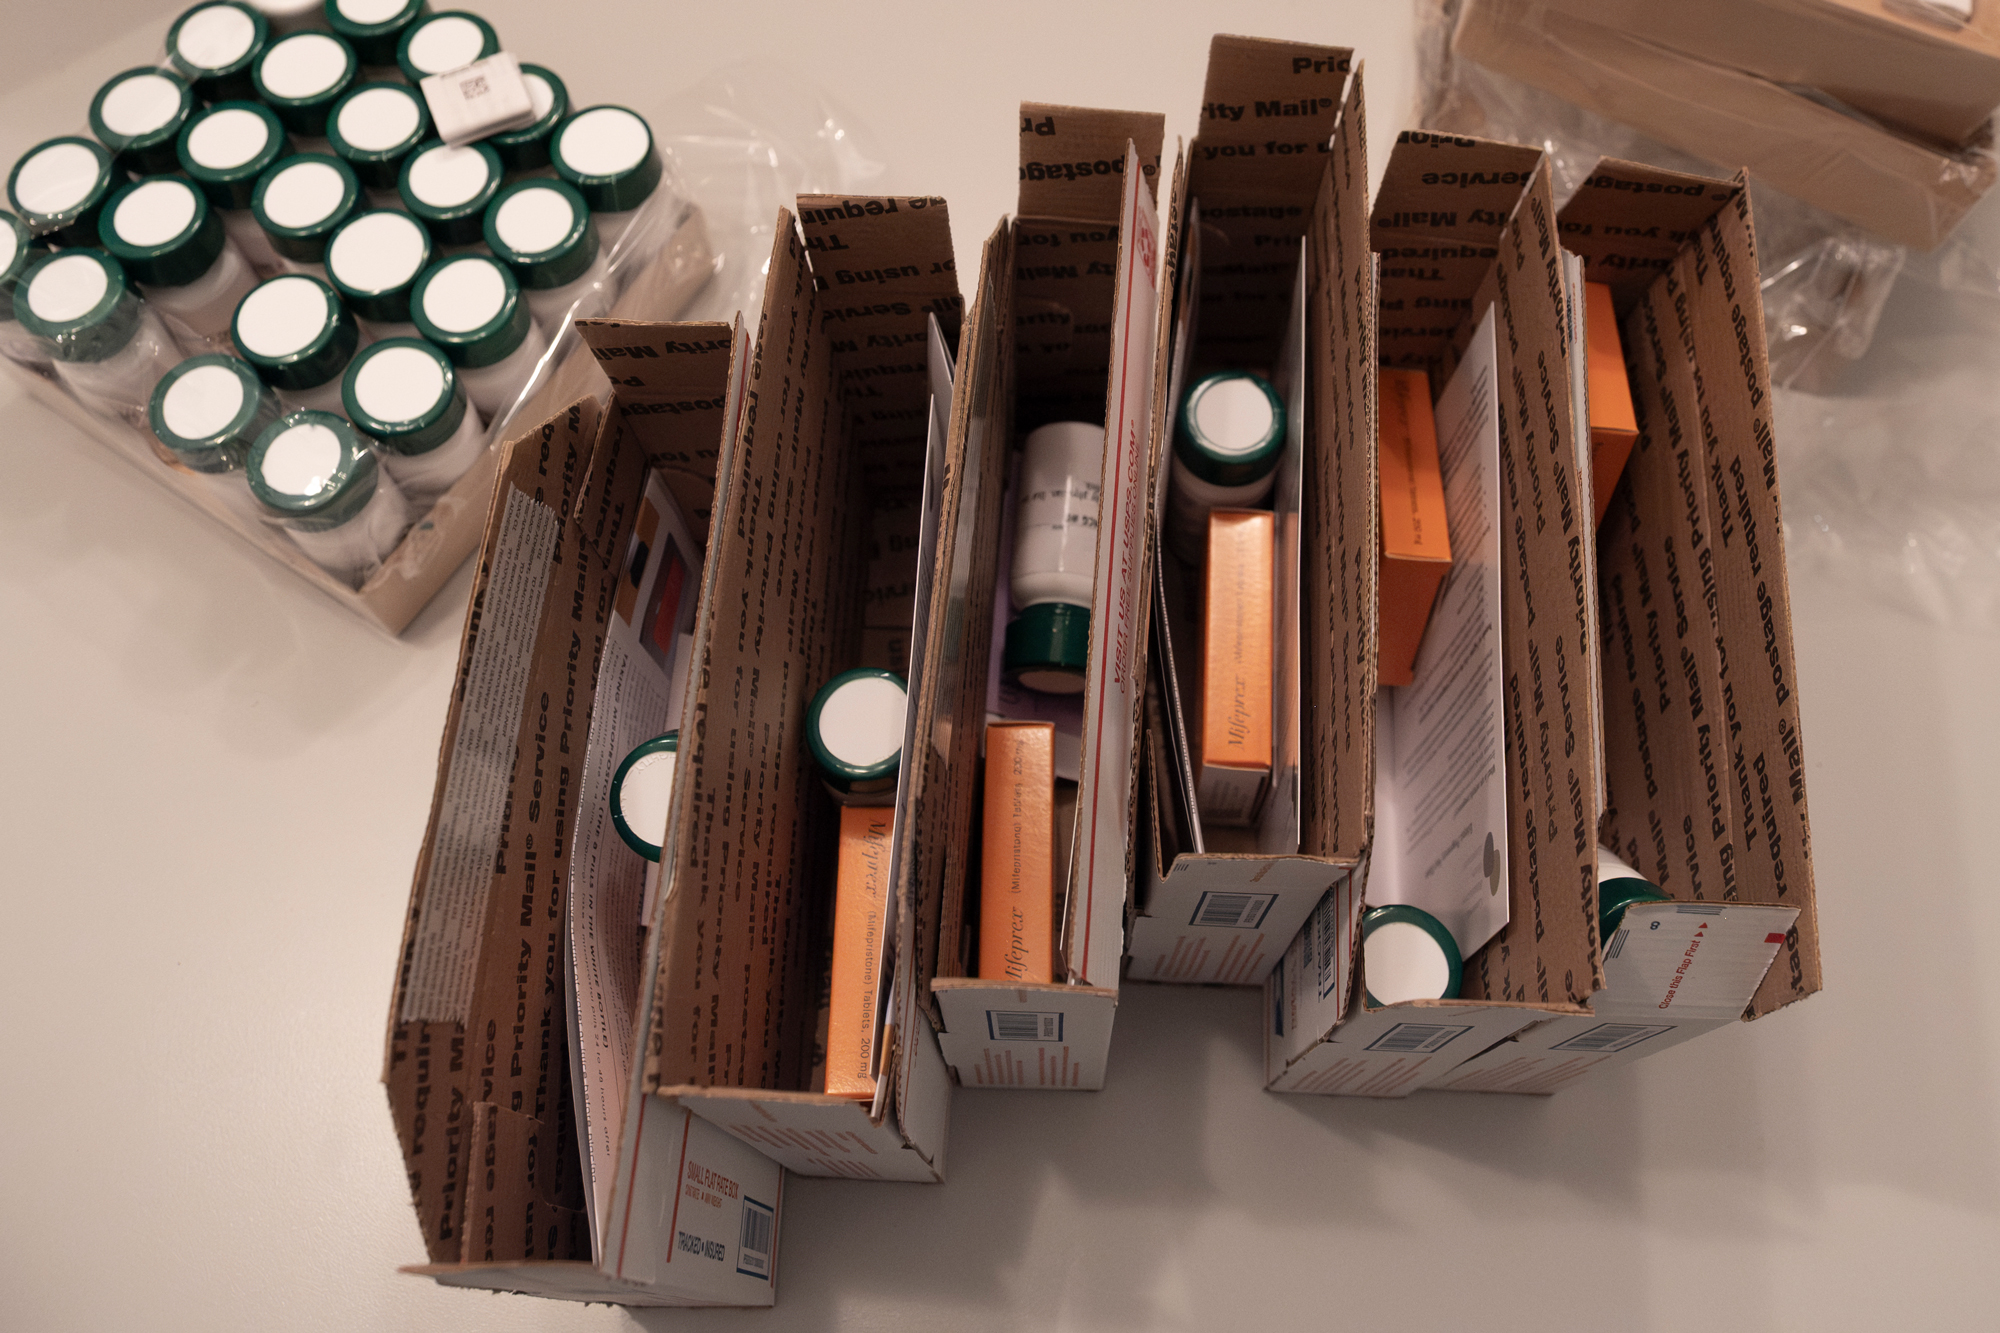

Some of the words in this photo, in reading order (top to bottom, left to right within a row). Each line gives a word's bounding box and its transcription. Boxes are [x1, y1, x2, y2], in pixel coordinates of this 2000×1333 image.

[1254, 98, 1332, 118] Mail®
[1204, 143, 1256, 160] you
[1264, 141, 1308, 155] for
[1604, 226, 1660, 239] you
[834, 264, 920, 286] using
[786, 306, 798, 365] you
[1731, 304, 1762, 410] postage
[780, 375, 790, 423] for
[1535, 351, 1560, 454] Service
[1699, 405, 1719, 456] you
[736, 391, 759, 537] required
[767, 431, 783, 519] using
[1497, 401, 1521, 513] required
[1523, 431, 1548, 535] Priority
[553, 442, 578, 564] Priority
[744, 476, 761, 577] Thank
[794, 446, 810, 559] Priority
[1553, 461, 1573, 535] Mail®
[1676, 448, 1702, 550] Priority
[1707, 456, 1736, 548] Thank
[1730, 454, 1762, 578] required
[492, 548, 504, 585] REMOVE
[776, 477, 794, 593] Service
[1120, 551, 1128, 583] AT
[486, 586, 496, 613] LINER
[506, 562, 518, 599] REMOVE
[518, 576, 530, 613] REMOVE
[524, 588, 534, 622] EXPOSE
[530, 575, 537, 587] TO
[754, 531, 773, 655] Priority
[1118, 587, 1127, 619] US
[1123, 587, 1131, 628] FREE
[1352, 547, 1367, 664] Priority
[1514, 516, 1536, 628] postage
[1561, 535, 1598, 655] Priority
[1661, 536, 1689, 639] Service
[499, 600, 509, 627] LINER
[513, 614, 522, 640] LINER
[737, 588, 749, 651] you
[1756, 581, 1790, 707] postage
[493, 657, 505, 695] REMOVE
[507, 670, 518, 707] REMOVE
[614, 654, 628, 703] TAKING
[1113, 624, 1125, 683] VISIT
[1120, 633, 1129, 693] ORDER
[1642, 609, 1674, 713] Priority
[1713, 635, 1730, 679] for
[501, 709, 510, 736] LINER
[559, 630, 582, 753] Priority
[732, 665, 743, 716] for
[772, 660, 789, 790] postage
[1227, 677, 1251, 748] Mifeprex
[1552, 636, 1576, 758] Service
[1723, 682, 1742, 740] you
[602, 706, 618, 801] MISOPROSTOL
[1506, 671, 1530, 801] required
[1631, 687, 1658, 799] postage
[1778, 715, 1804, 805] Mail®
[552, 766, 570, 858] using
[687, 703, 708, 866] required
[722, 728, 737, 827] using
[752, 726, 769, 849] Priority
[1535, 720, 1560, 842] Priority
[1567, 769, 1587, 857] Mail®
[1693, 724, 1729, 840] Priority
[1733, 746, 1757, 851] Thank
[699, 788, 716, 904] Thank
[735, 769, 751, 902] Service
[861, 821, 886, 893] Mifeprex
[1752, 752, 1788, 898] required
[510, 939, 531, 1077] Priority
[528, 692, 550, 823] Service
[547, 869, 561, 920] for
[588, 894, 594, 910] IN
[760, 802, 779, 945] required
[1522, 809, 1545, 943] postage
[712, 841, 729, 979] Priority
[768, 875, 782, 975] Thank
[1650, 921, 1660, 930] 8
[544, 933, 556, 996] you
[590, 945, 599, 987] WHITE
[693, 920, 705, 990] you
[863, 913, 876, 985] (Mifepristone)
[1670, 973, 1683, 989] this
[1676, 957, 1692, 976] Flap
[1684, 940, 1700, 958] First
[597, 992, 608, 1048] BOTTLE)
[689, 1005, 701, 1063] for
[761, 988, 772, 1047] you
[860, 990, 872, 1032] Tablets,
[1658, 987, 1676, 1010] Close
[534, 1007, 552, 1119] Thank
[857, 1061, 868, 1079] mg
[859, 1038, 870, 1058] 200
[439, 1088, 464, 1241] Priority
[527, 1133, 538, 1188] for
[687, 1161, 704, 1186] SMALL
[704, 1168, 717, 1190] FLAT
[716, 1175, 729, 1196] RATE
[728, 1181, 739, 1200] BOX
[678, 1231, 701, 1256] TRACKED
[704, 1240, 725, 1262] INSURED
